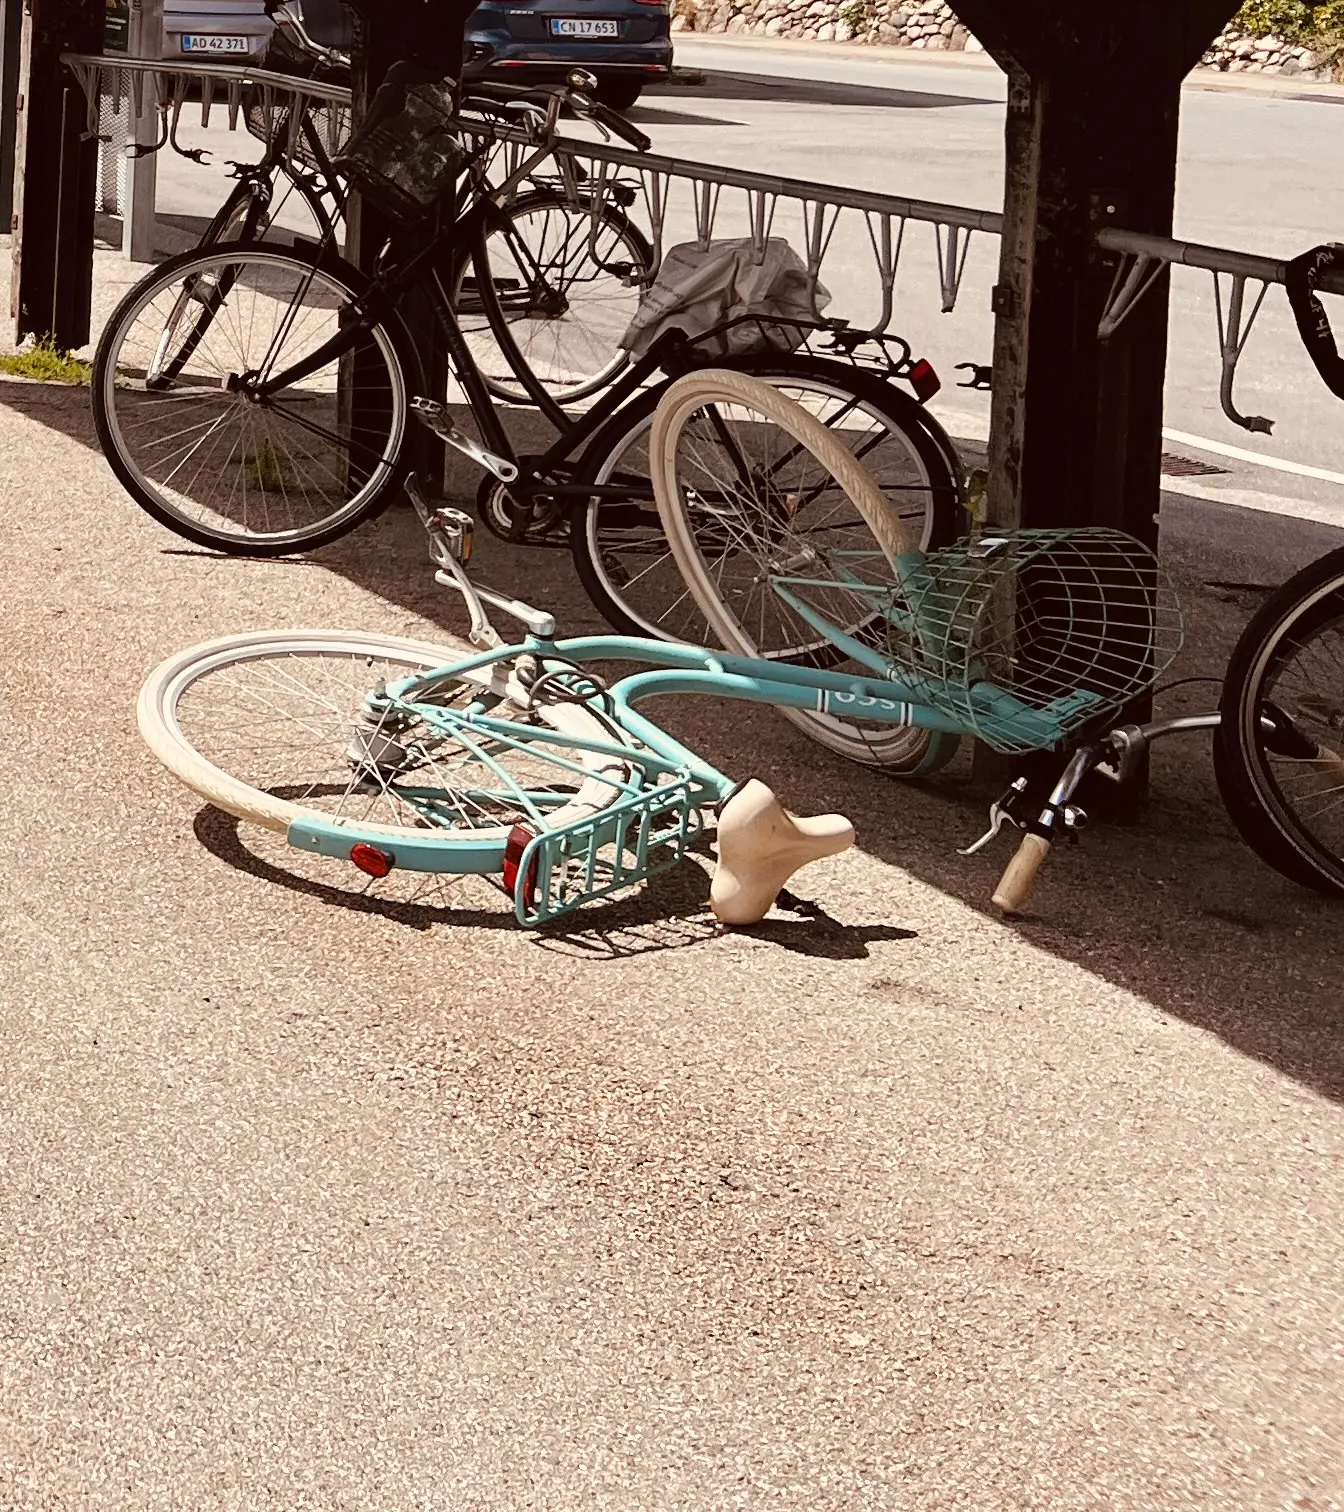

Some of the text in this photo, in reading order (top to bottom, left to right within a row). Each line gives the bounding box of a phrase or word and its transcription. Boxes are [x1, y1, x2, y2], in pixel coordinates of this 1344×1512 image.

[560, 21, 616, 35] CN 17 653
[192, 38, 246, 50] AD 42 371
